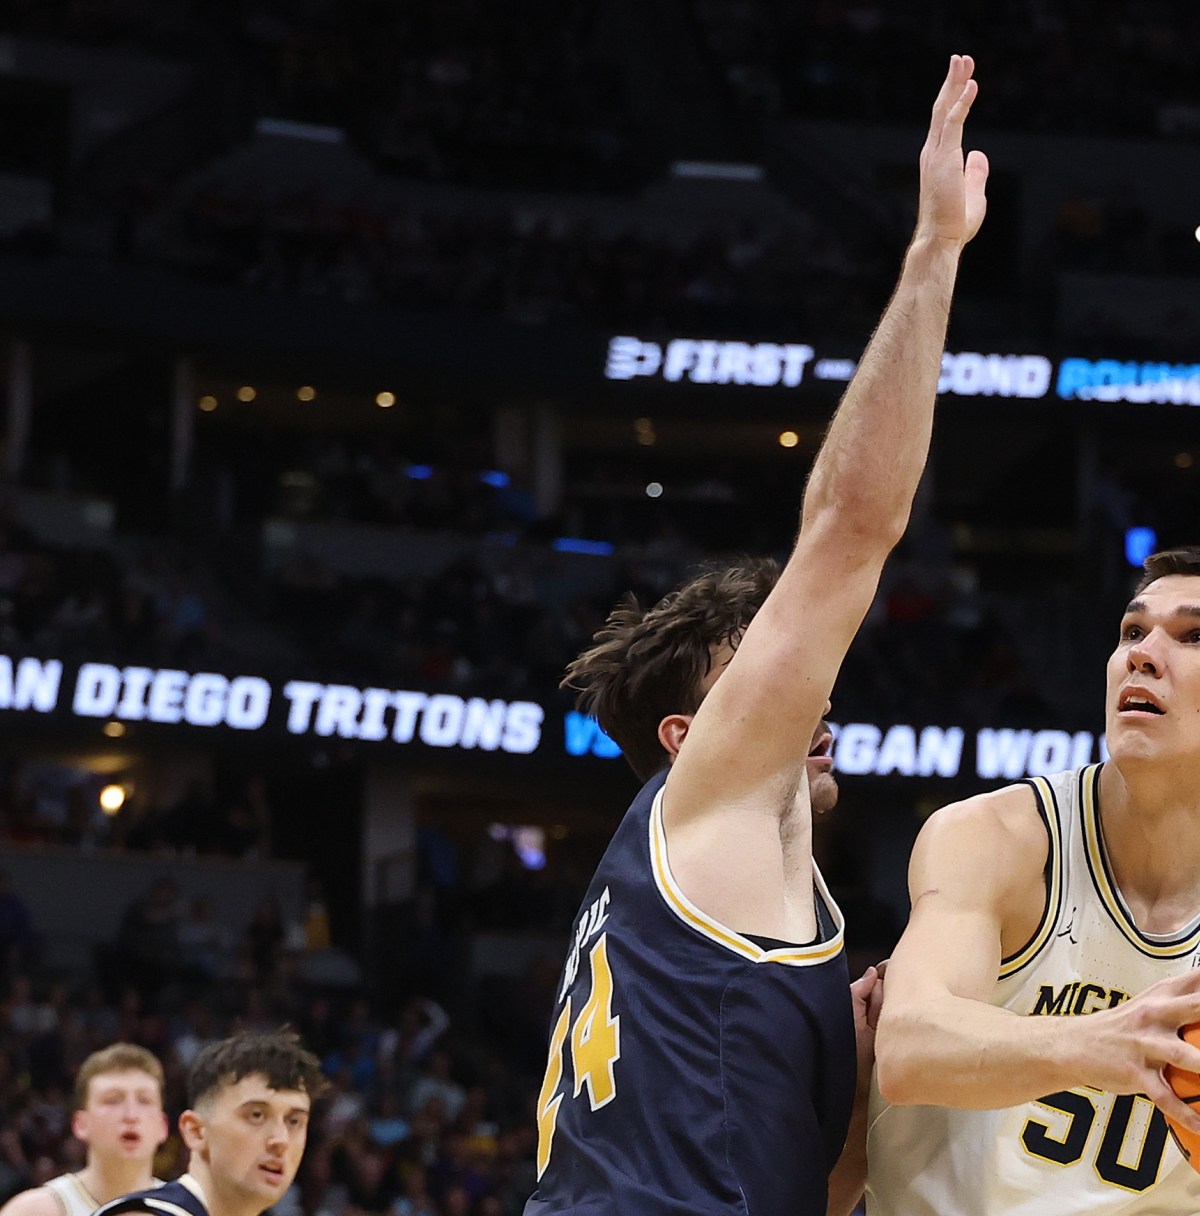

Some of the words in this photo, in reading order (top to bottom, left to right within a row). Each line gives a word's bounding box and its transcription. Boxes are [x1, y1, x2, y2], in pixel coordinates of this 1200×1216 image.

[663, 338, 815, 388] FIRST
[72, 662, 272, 731] DIEGO
[283, 680, 545, 755] TRITONS
[1020, 1086, 1170, 1195] 50
